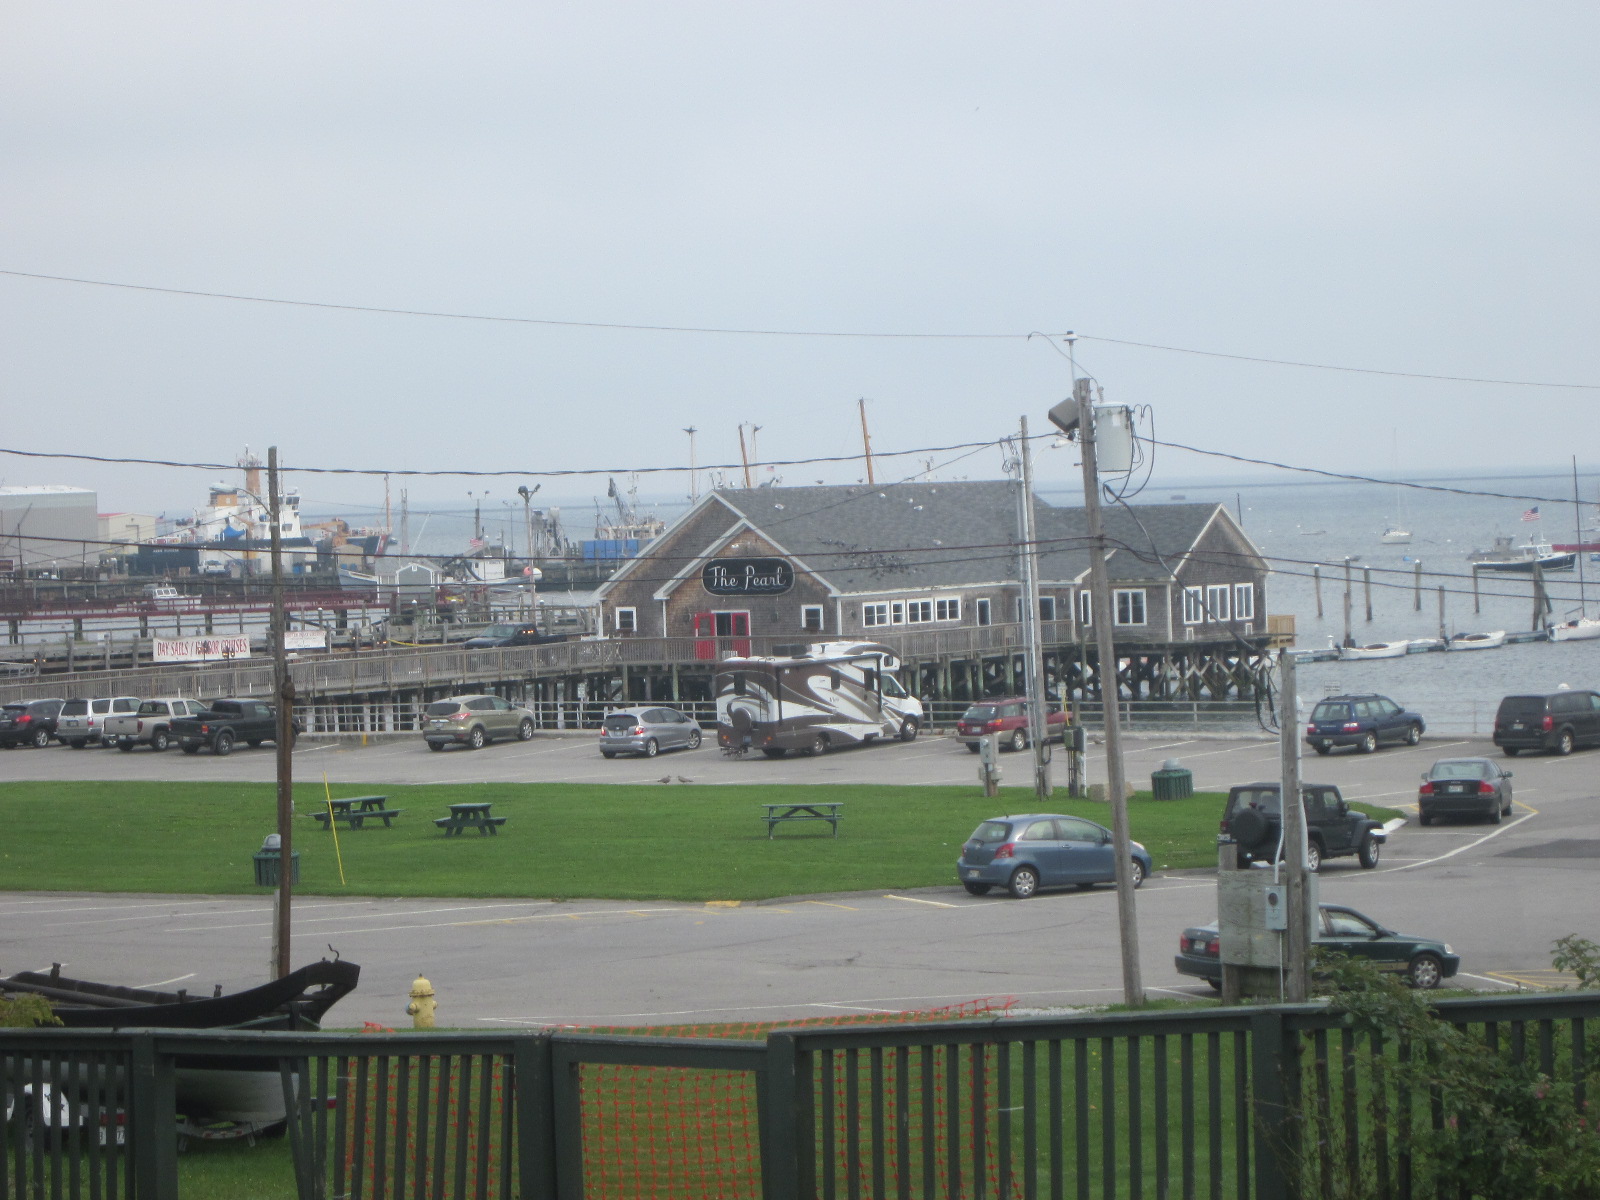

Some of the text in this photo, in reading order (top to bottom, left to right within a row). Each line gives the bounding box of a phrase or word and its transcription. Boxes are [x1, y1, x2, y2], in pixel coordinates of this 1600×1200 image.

[708, 565, 786, 591] The Pearl
[158, 641, 169, 657] DAY
[171, 641, 189, 656] SAILS
